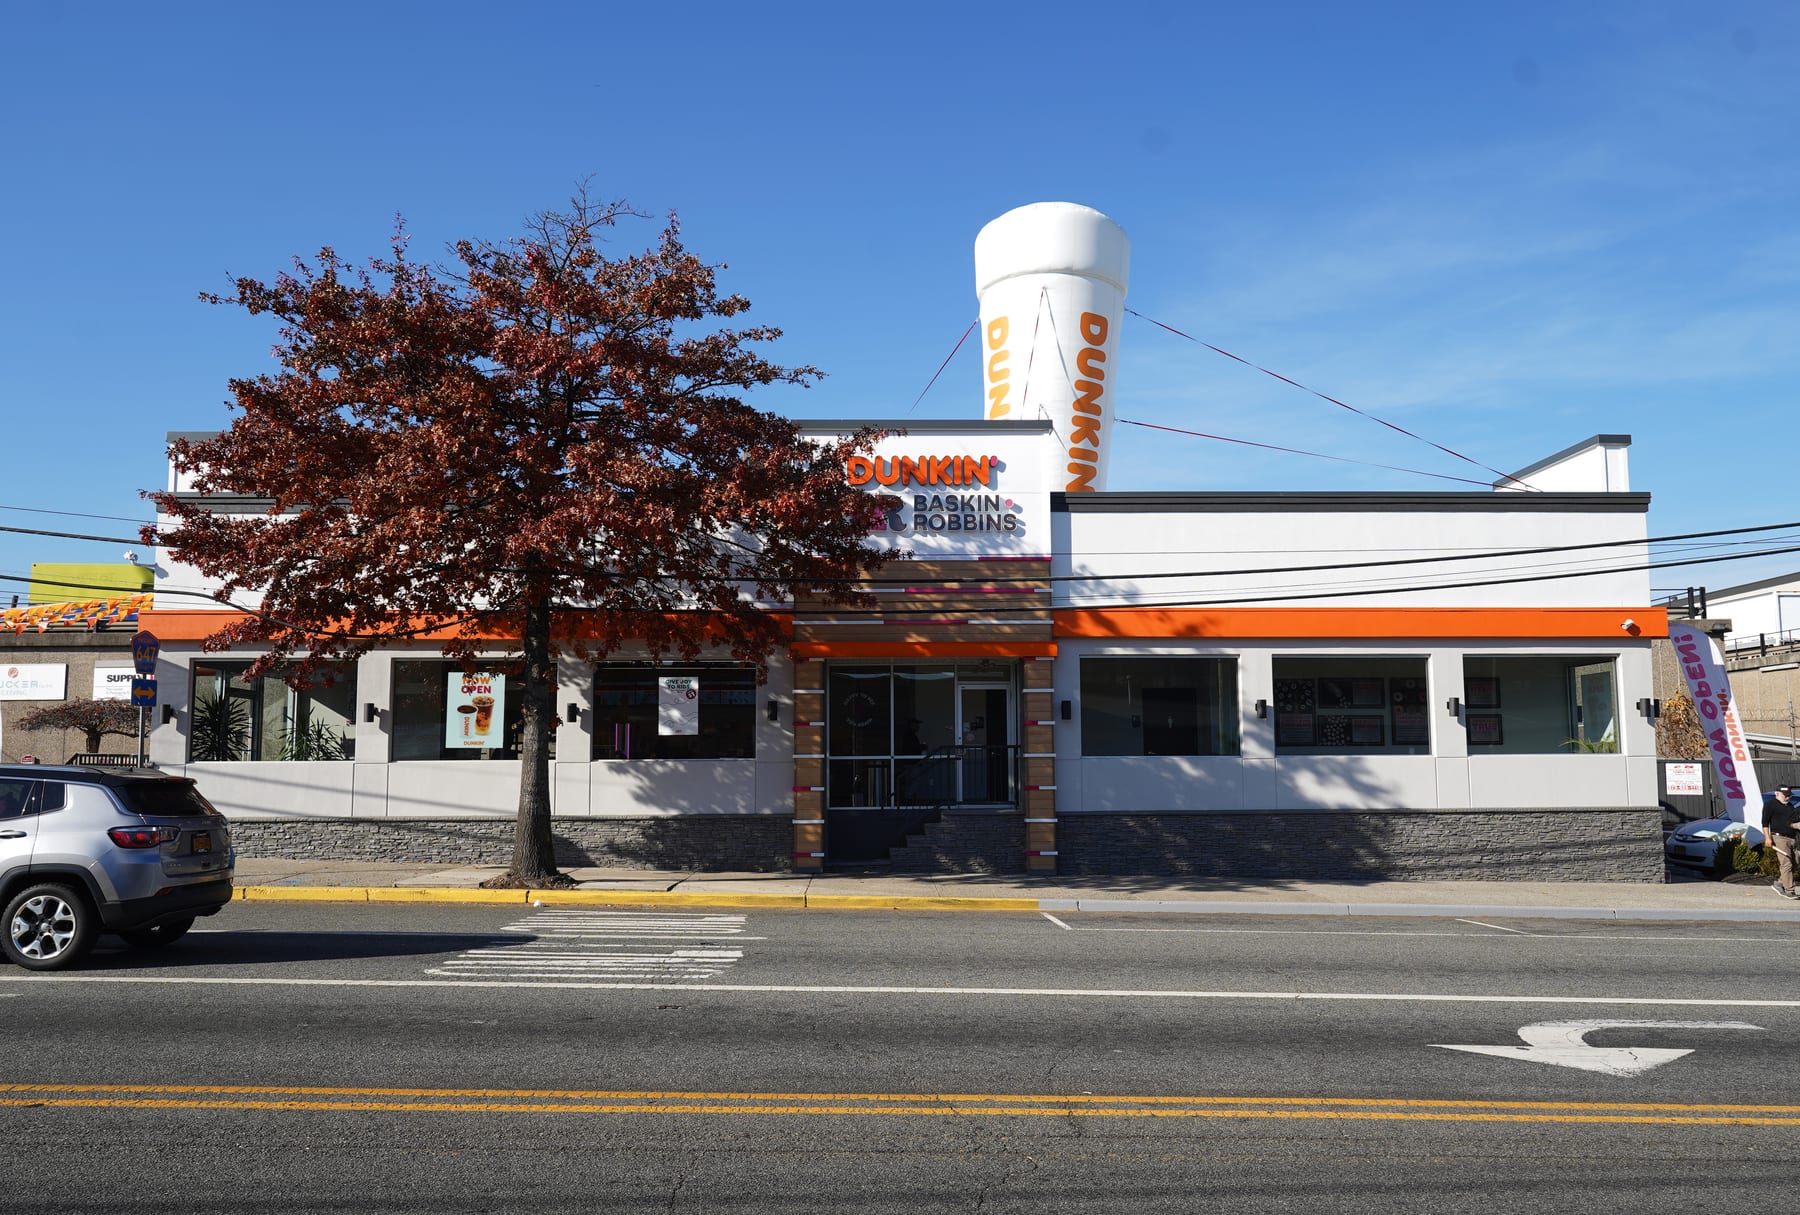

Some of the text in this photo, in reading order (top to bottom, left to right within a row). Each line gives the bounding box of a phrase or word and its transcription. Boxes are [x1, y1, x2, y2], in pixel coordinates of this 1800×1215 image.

[1066, 311, 1108, 492] DUNKIN
[847, 455, 998, 486] DUNKIN'
[913, 494, 1000, 512] BASKIN
[913, 513, 1017, 531] ROBBINS
[136, 646, 156, 662] 647
[461, 685, 491, 694] OPEN
